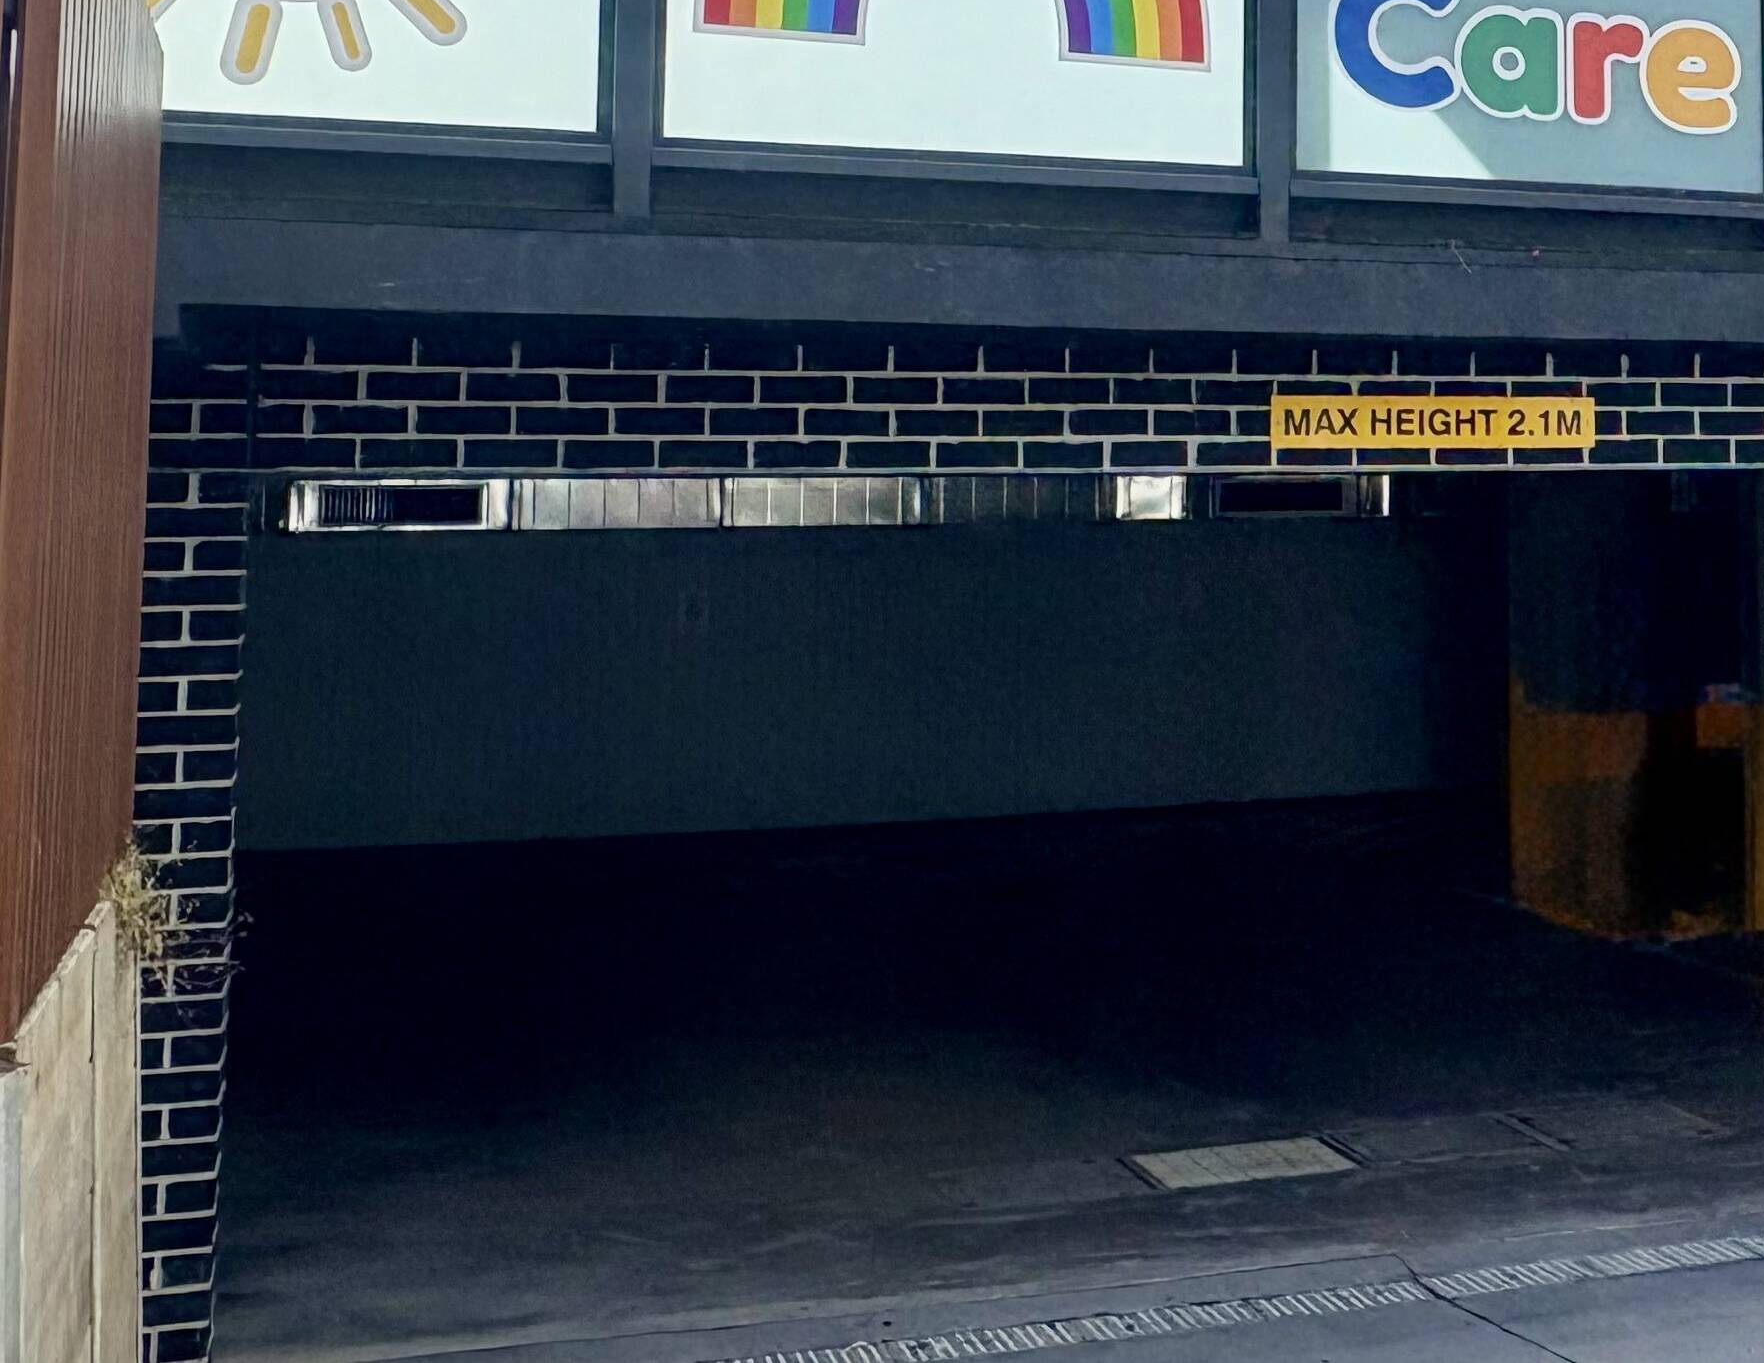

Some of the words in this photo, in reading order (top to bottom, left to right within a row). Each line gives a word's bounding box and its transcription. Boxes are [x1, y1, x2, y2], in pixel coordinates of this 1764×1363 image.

[1283, 407, 1359, 436] MAX
[1370, 407, 1498, 437] HEIGHT
[1507, 409, 1582, 437] 2.1M
